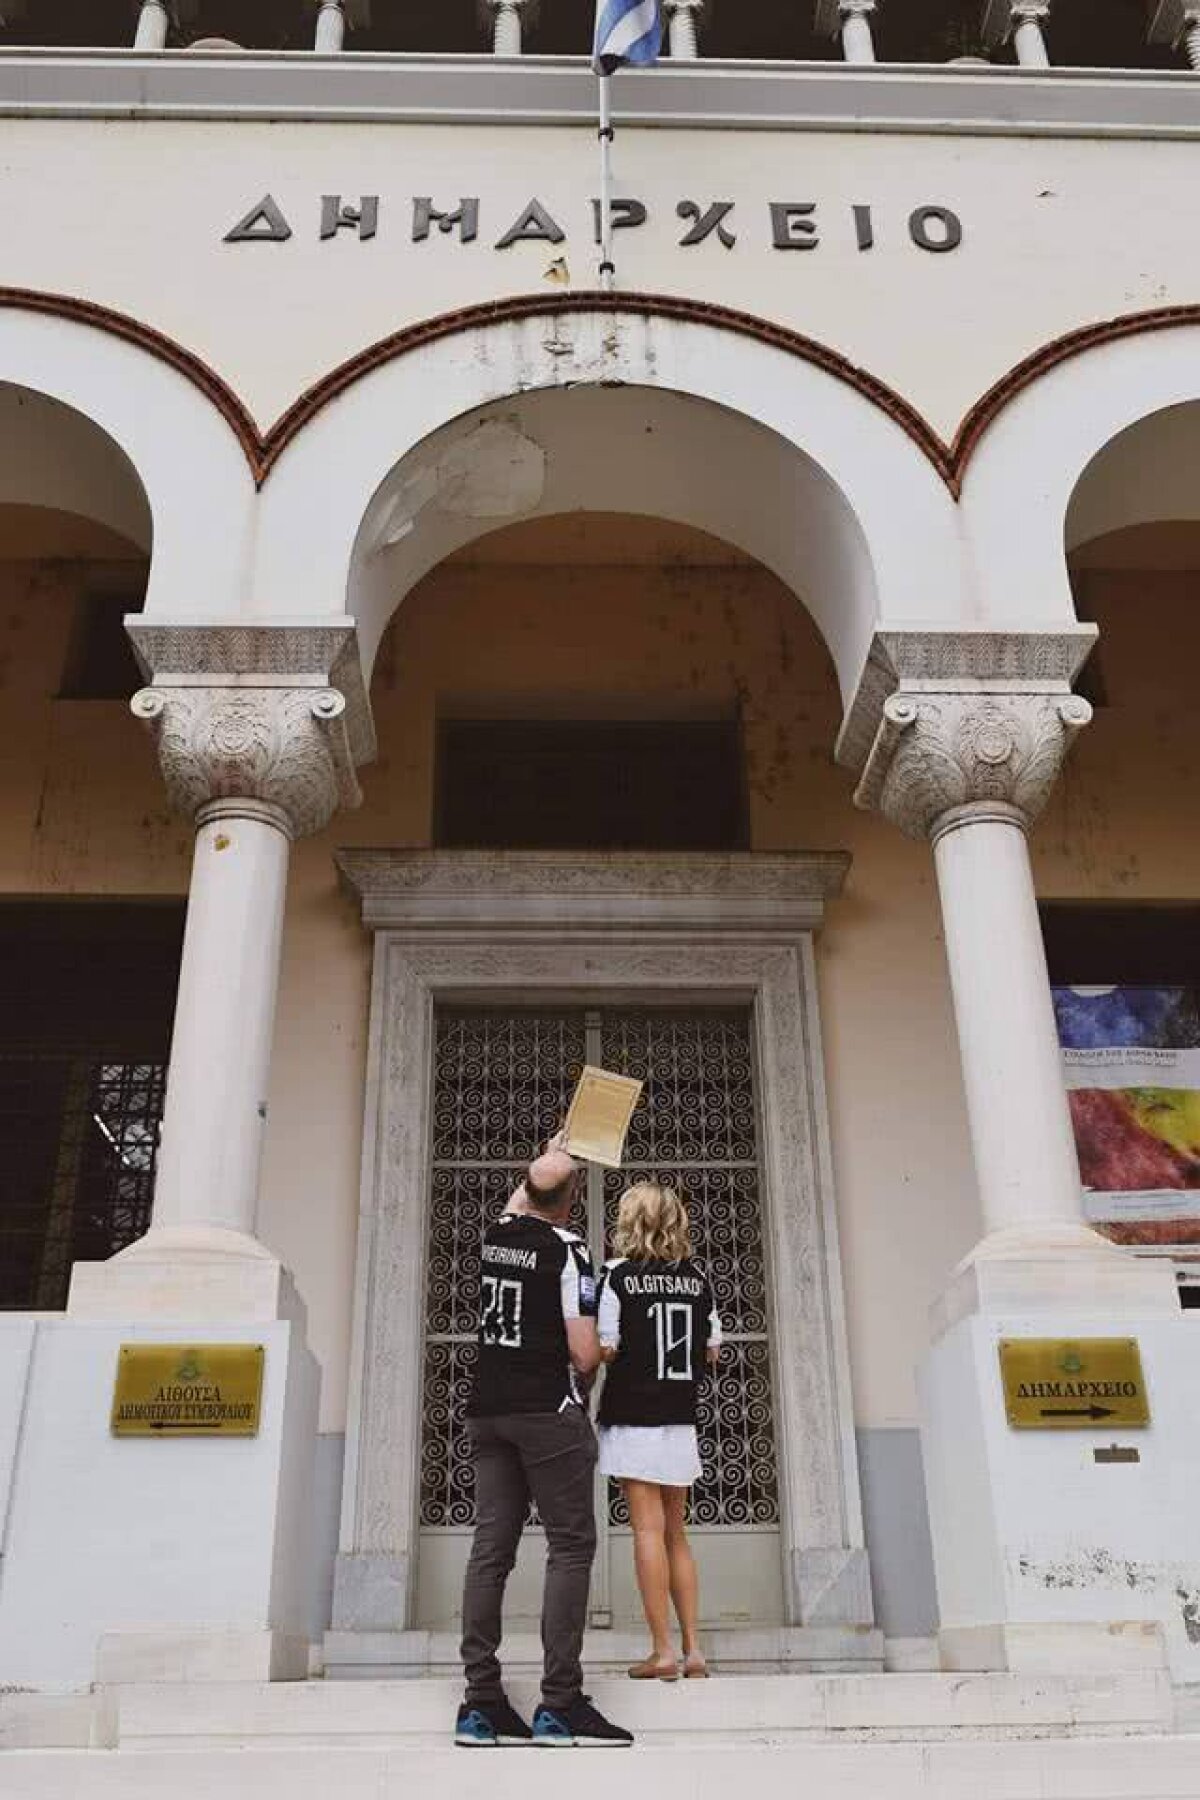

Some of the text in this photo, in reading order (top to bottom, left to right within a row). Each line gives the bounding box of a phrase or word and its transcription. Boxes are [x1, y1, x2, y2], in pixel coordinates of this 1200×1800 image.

[222, 193, 963, 252] ΔΗΜΑΡΧΕΙΟ
[647, 1302, 693, 1381] 19
[155, 1386, 222, 1401] ΑΙΘΟΥΣΑ
[1017, 1381, 1137, 1398] ΔΗΜΑΡΧΕΙΟ
